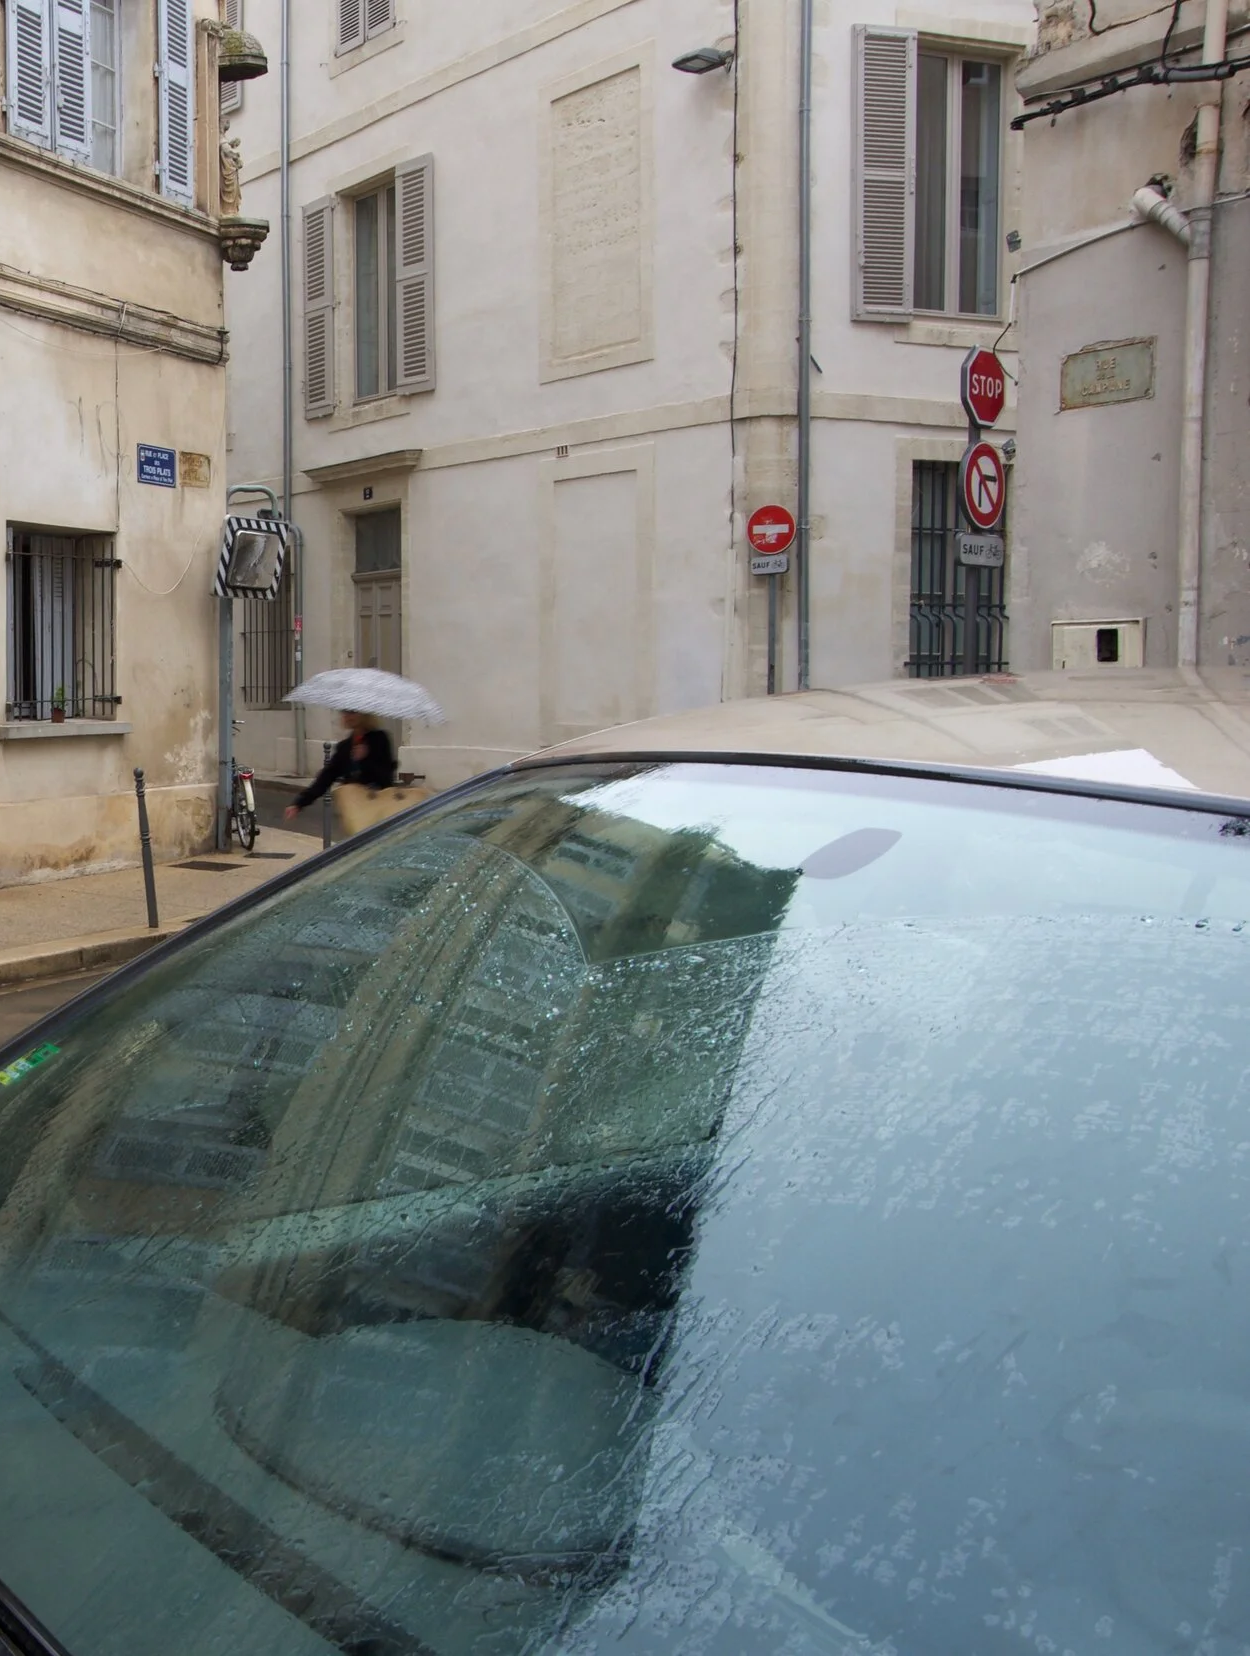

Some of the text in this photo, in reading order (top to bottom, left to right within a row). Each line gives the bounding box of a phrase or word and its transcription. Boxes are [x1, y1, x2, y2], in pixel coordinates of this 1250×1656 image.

[1095, 356, 1117, 370] RUE
[971, 373, 1003, 400] STOP
[143, 465, 156, 475] TROIS
[963, 543, 985, 556] SAUF
[752, 561, 770, 570] SAUF
